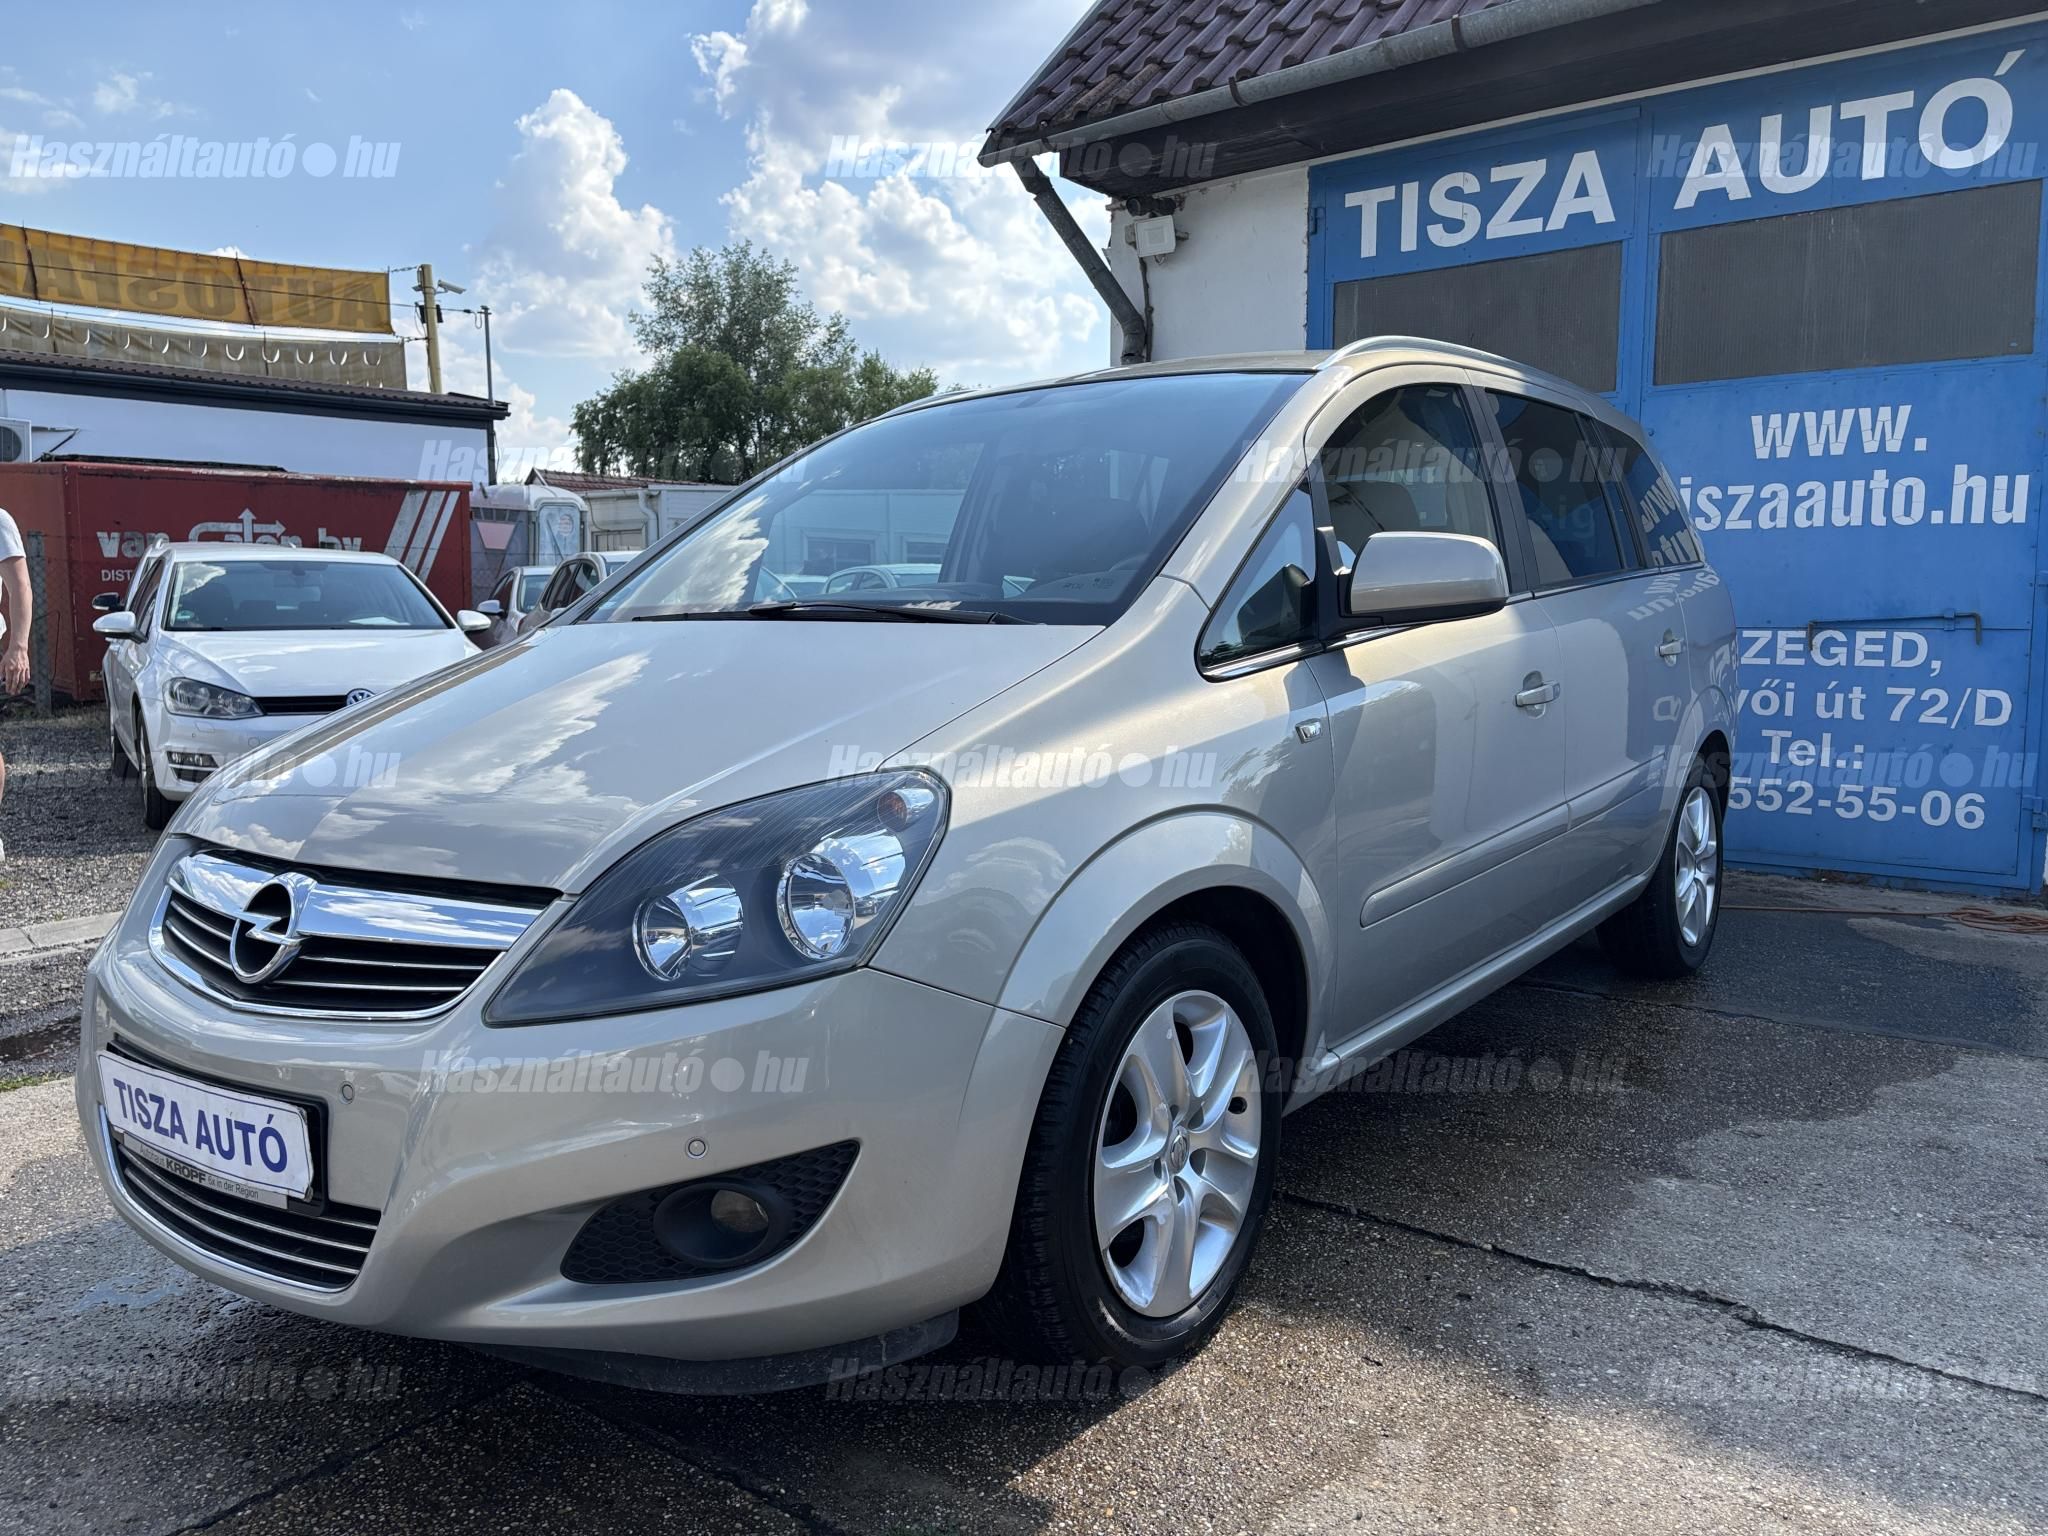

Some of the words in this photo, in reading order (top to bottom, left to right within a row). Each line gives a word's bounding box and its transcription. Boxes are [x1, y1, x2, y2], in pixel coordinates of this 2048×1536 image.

[1344, 150, 1616, 258] TISZA
[1673, 49, 2027, 210] AUTÓ
[1750, 404, 1928, 459] www.
[1815, 680, 1867, 721] út
[1886, 686, 2013, 729] 72/D
[1761, 729, 1865, 770] Tel.:
[113, 1078, 189, 1145] TISZA
[195, 1109, 289, 1174] AUTÓ
[166, 1158, 206, 1183] KROPF
[223, 1181, 234, 1193] der
[235, 1183, 259, 1201] Region
